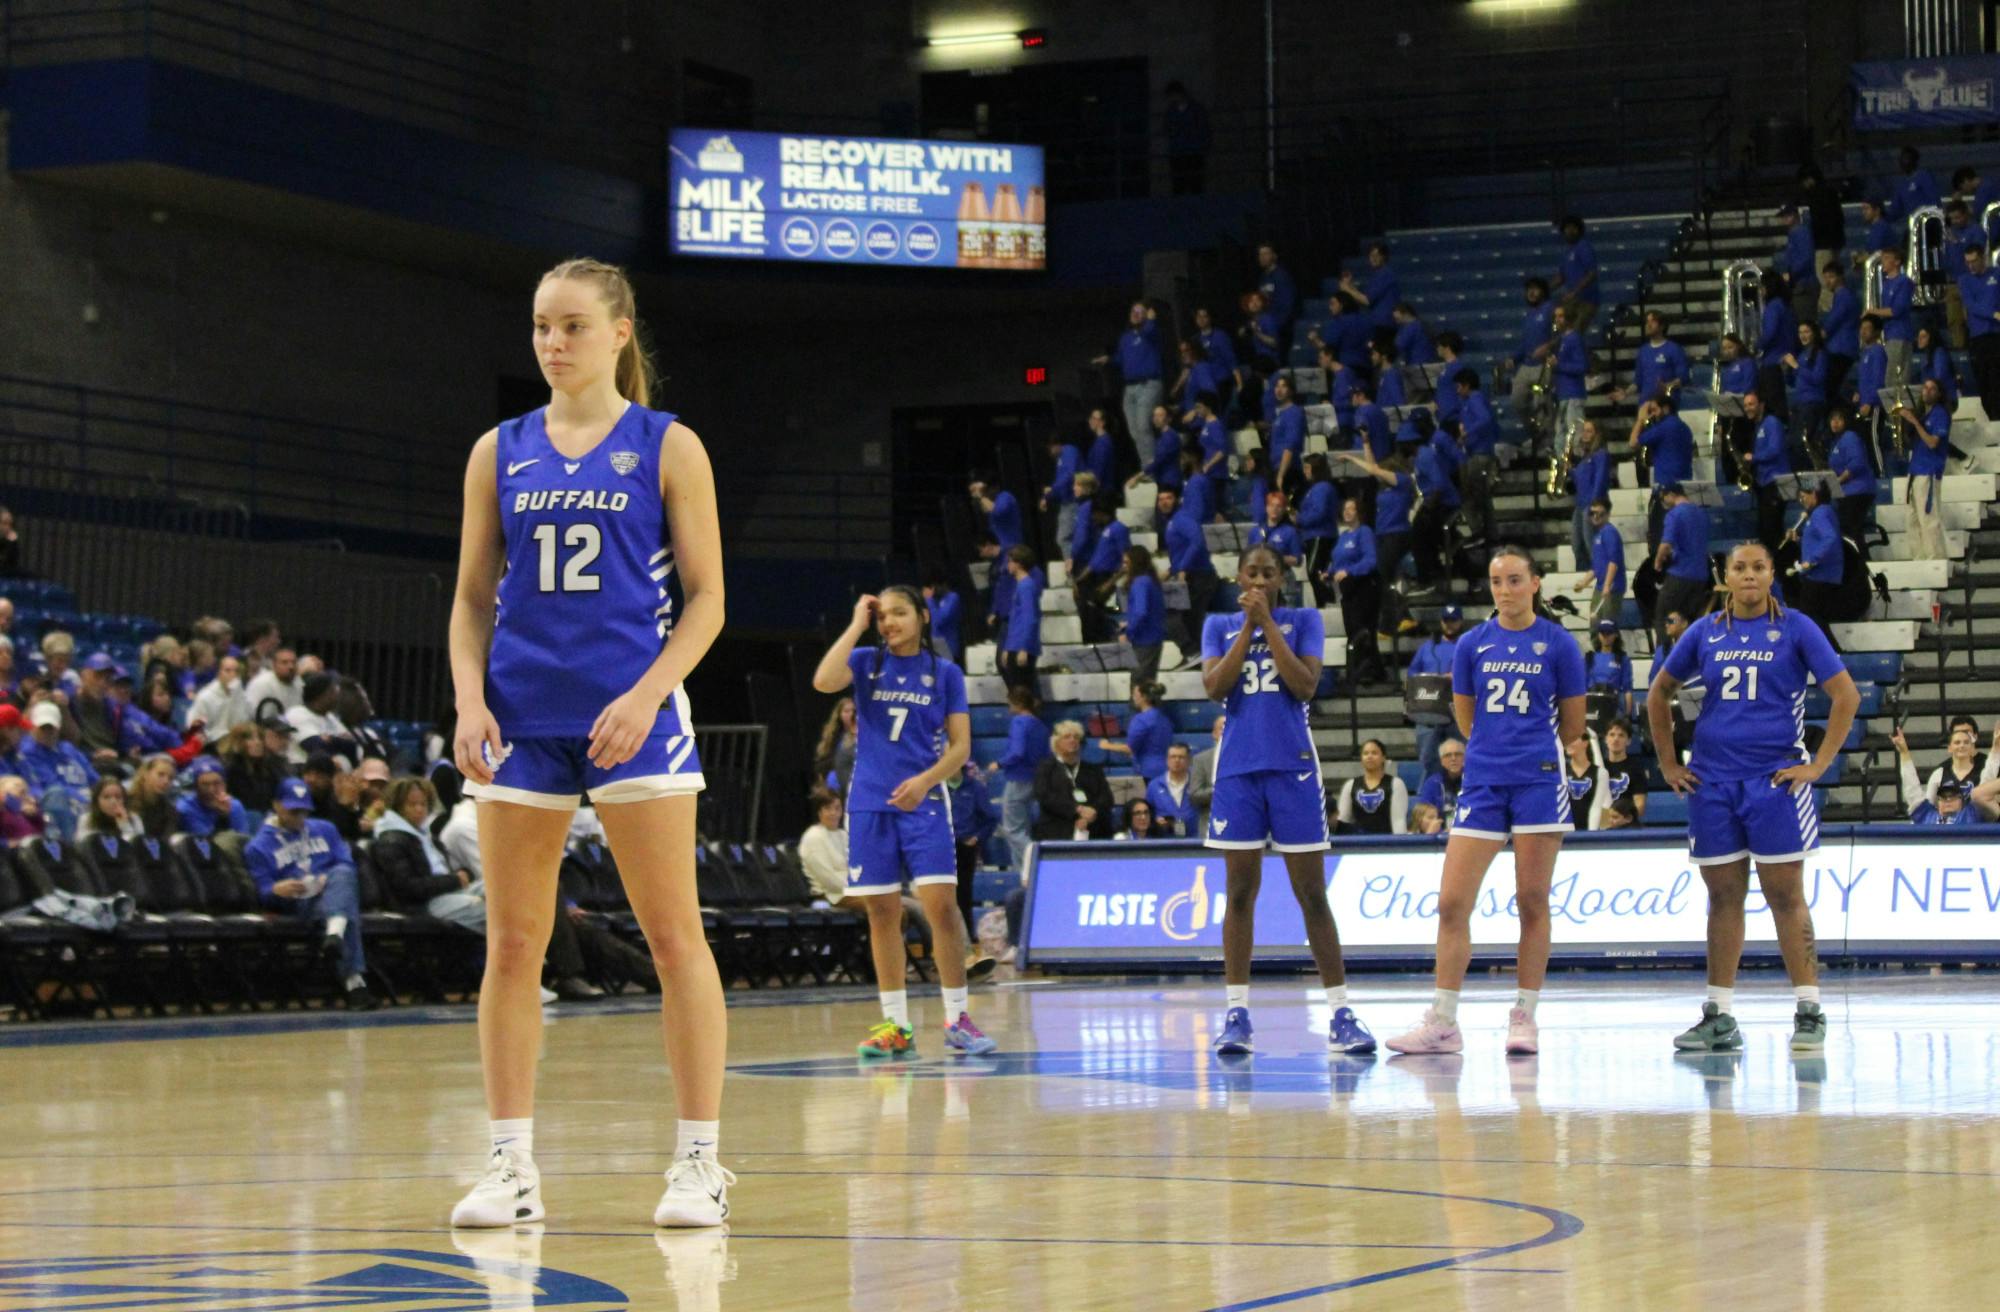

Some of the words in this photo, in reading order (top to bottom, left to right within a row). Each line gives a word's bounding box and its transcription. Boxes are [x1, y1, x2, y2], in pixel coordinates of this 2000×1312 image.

[781, 137, 925, 168] RECOVER
[929, 145, 1012, 173] WITH
[680, 178, 765, 211] MILK
[781, 163, 864, 191] REAL
[869, 169, 950, 195] MILK.
[781, 192, 867, 212] LACTOSE
[871, 194, 923, 214] FREE.
[691, 209, 766, 243] LIFE
[514, 490, 629, 514] BUFFALO
[533, 523, 602, 592] 12
[1482, 661, 1542, 675] BUFFALO
[1714, 650, 1774, 662] BUFFALO
[1242, 658, 1280, 695] 32
[1722, 665, 1758, 700] 21
[872, 689, 931, 706] BUFFALO
[1486, 678, 1530, 714] 24
[888, 707, 909, 742] 7
[1077, 893, 1158, 926] TASTE
[1549, 869, 1693, 925] Local
